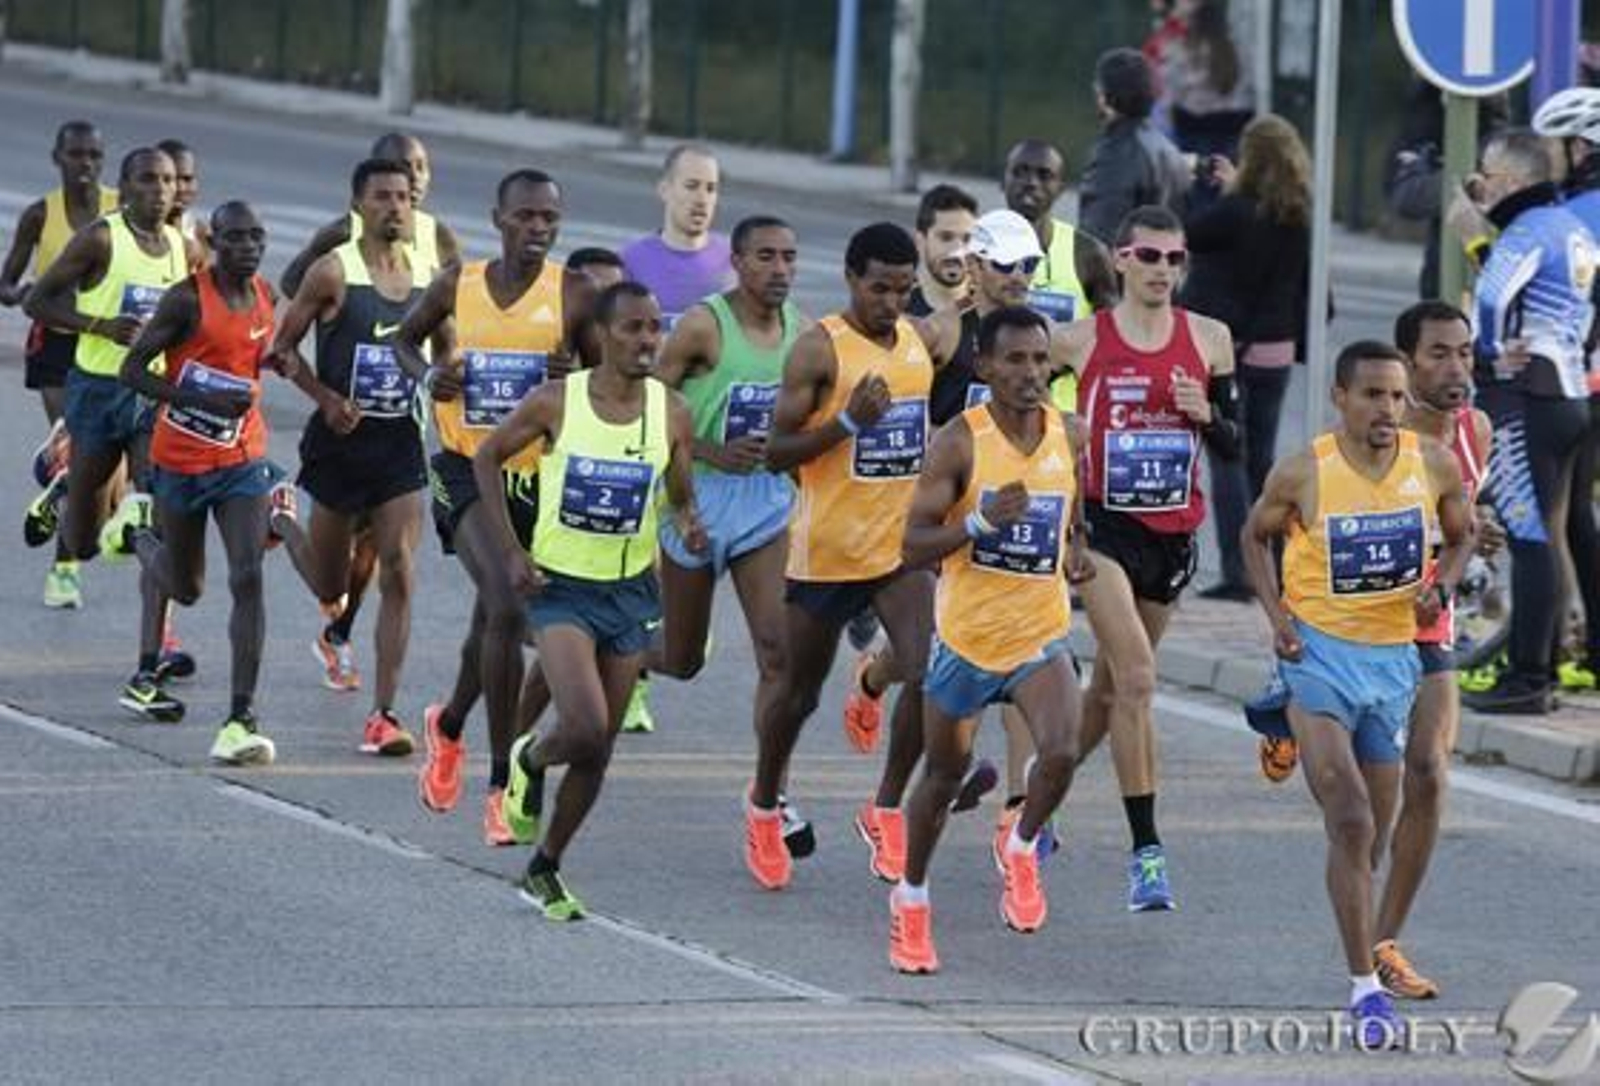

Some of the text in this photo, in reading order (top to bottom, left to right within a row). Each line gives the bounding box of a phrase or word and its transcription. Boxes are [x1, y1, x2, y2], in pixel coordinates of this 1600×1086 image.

[491, 380, 515, 398] 16
[887, 430, 906, 448] 18
[1138, 436, 1184, 452] ZURICH
[596, 463, 644, 480] ZURICH
[1142, 461, 1161, 478] 11
[599, 487, 613, 506] 2
[1361, 515, 1418, 532] ZURICH
[1012, 524, 1032, 543] 13
[1367, 543, 1391, 561] 14
